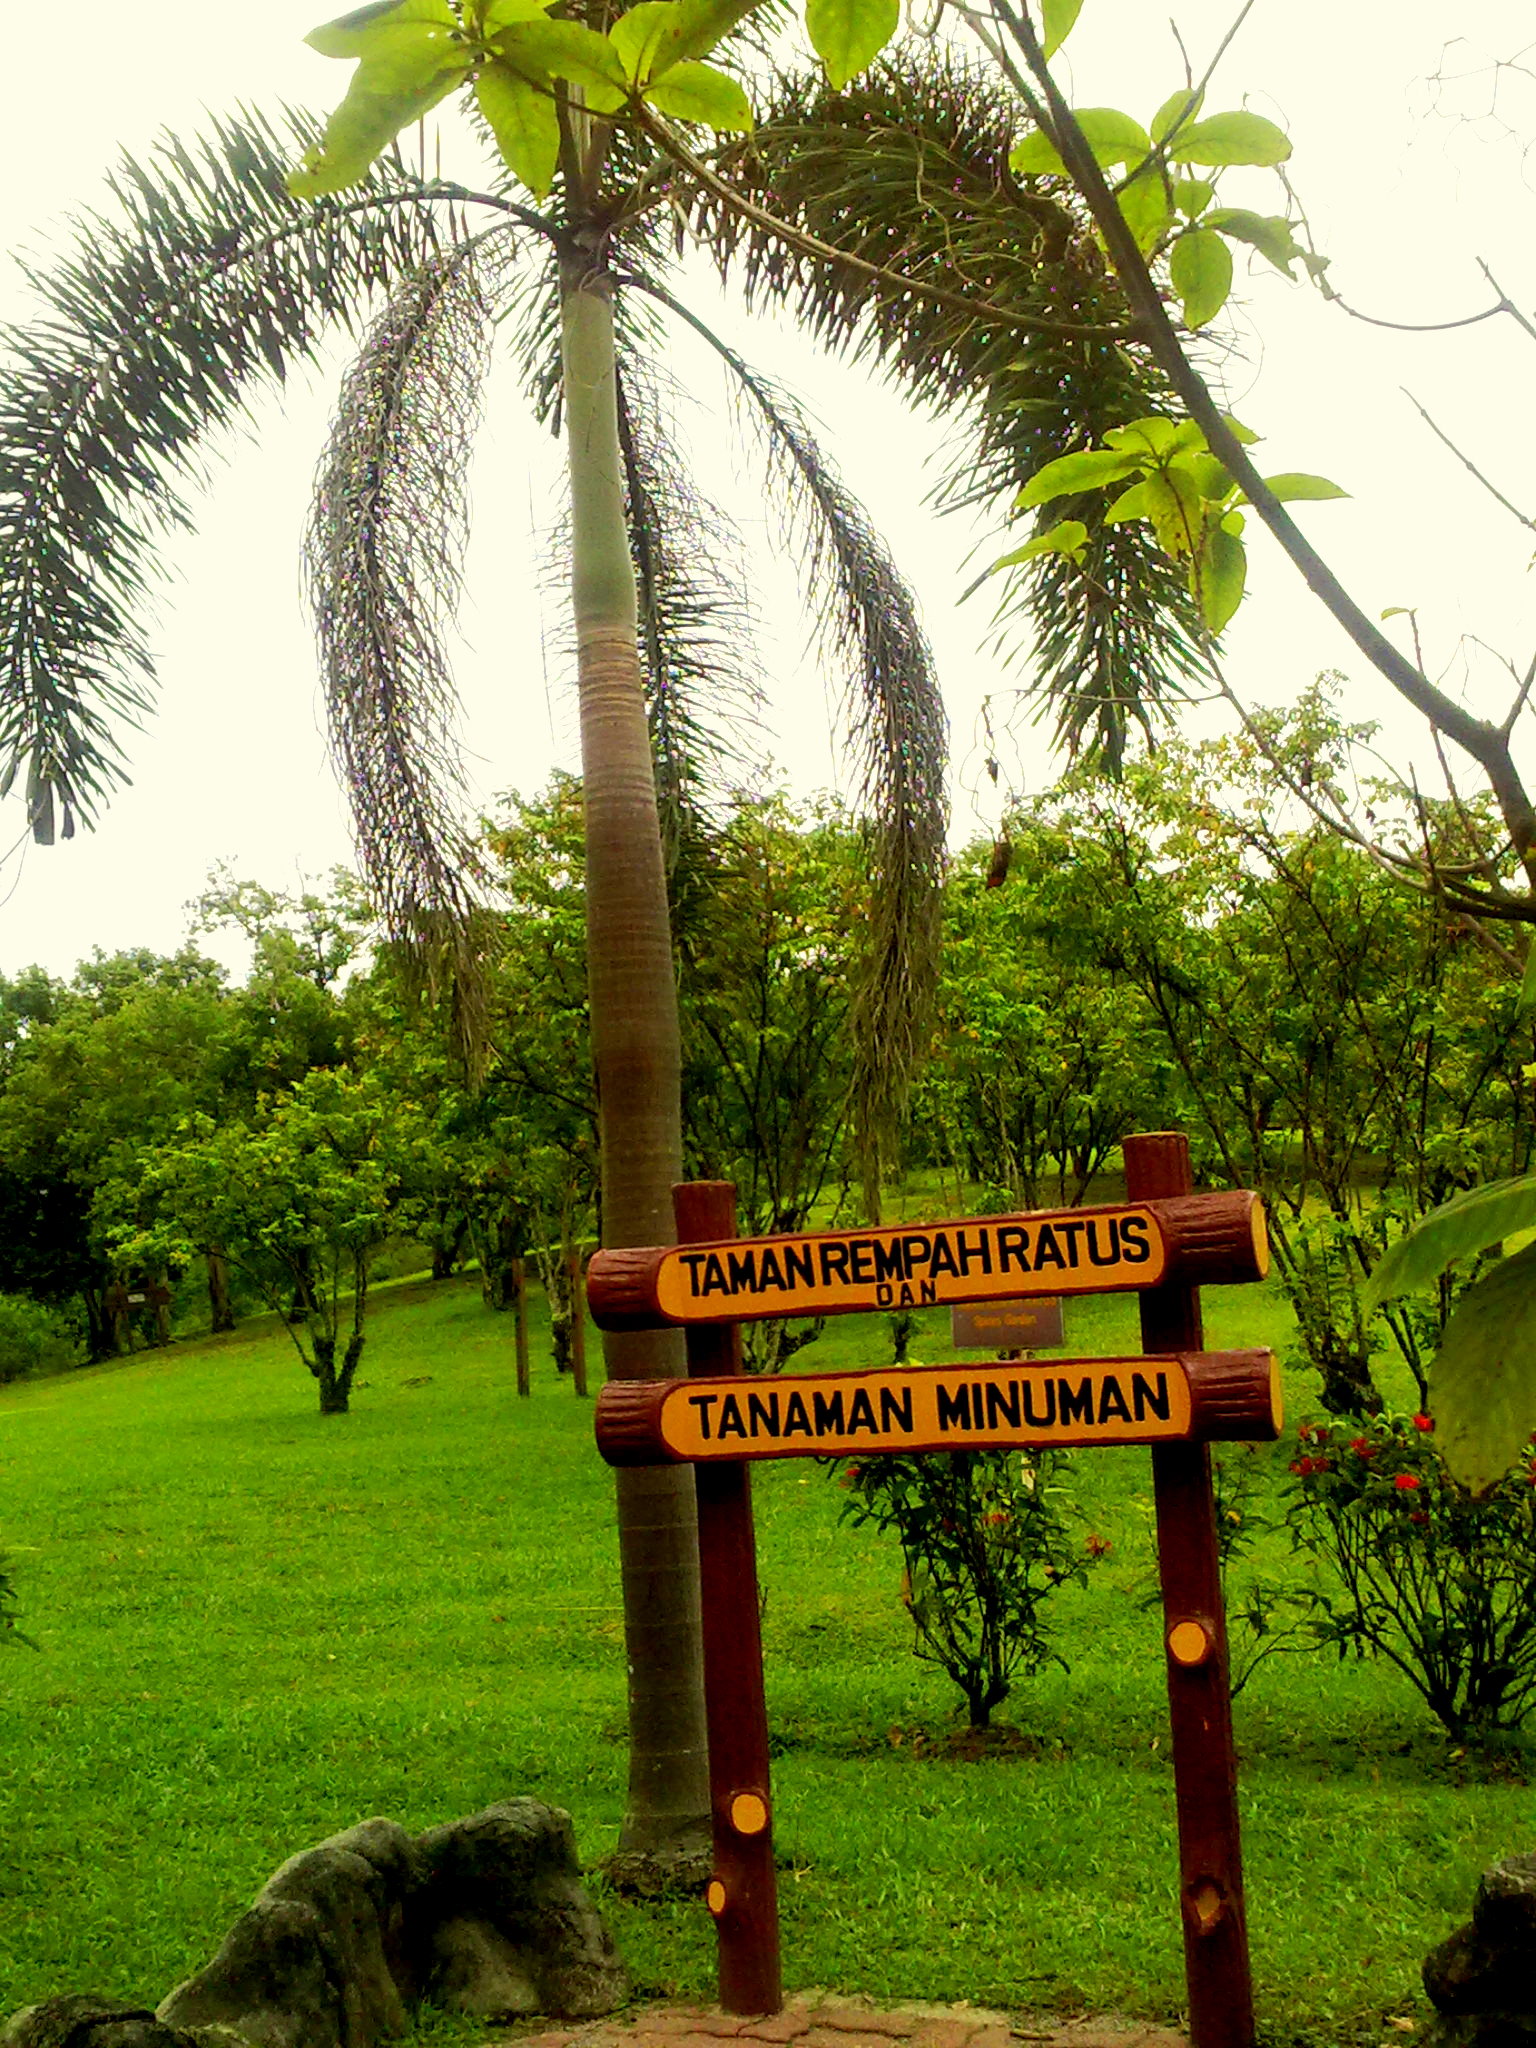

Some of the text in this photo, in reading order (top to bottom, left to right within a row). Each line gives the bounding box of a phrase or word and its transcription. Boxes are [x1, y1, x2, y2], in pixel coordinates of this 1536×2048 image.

[679, 1216, 1151, 1297] TAMAN REMPAH RATUS
[876, 1279, 937, 1306] DAN
[688, 1372, 1170, 1440] TANAMAN MINUMAN
